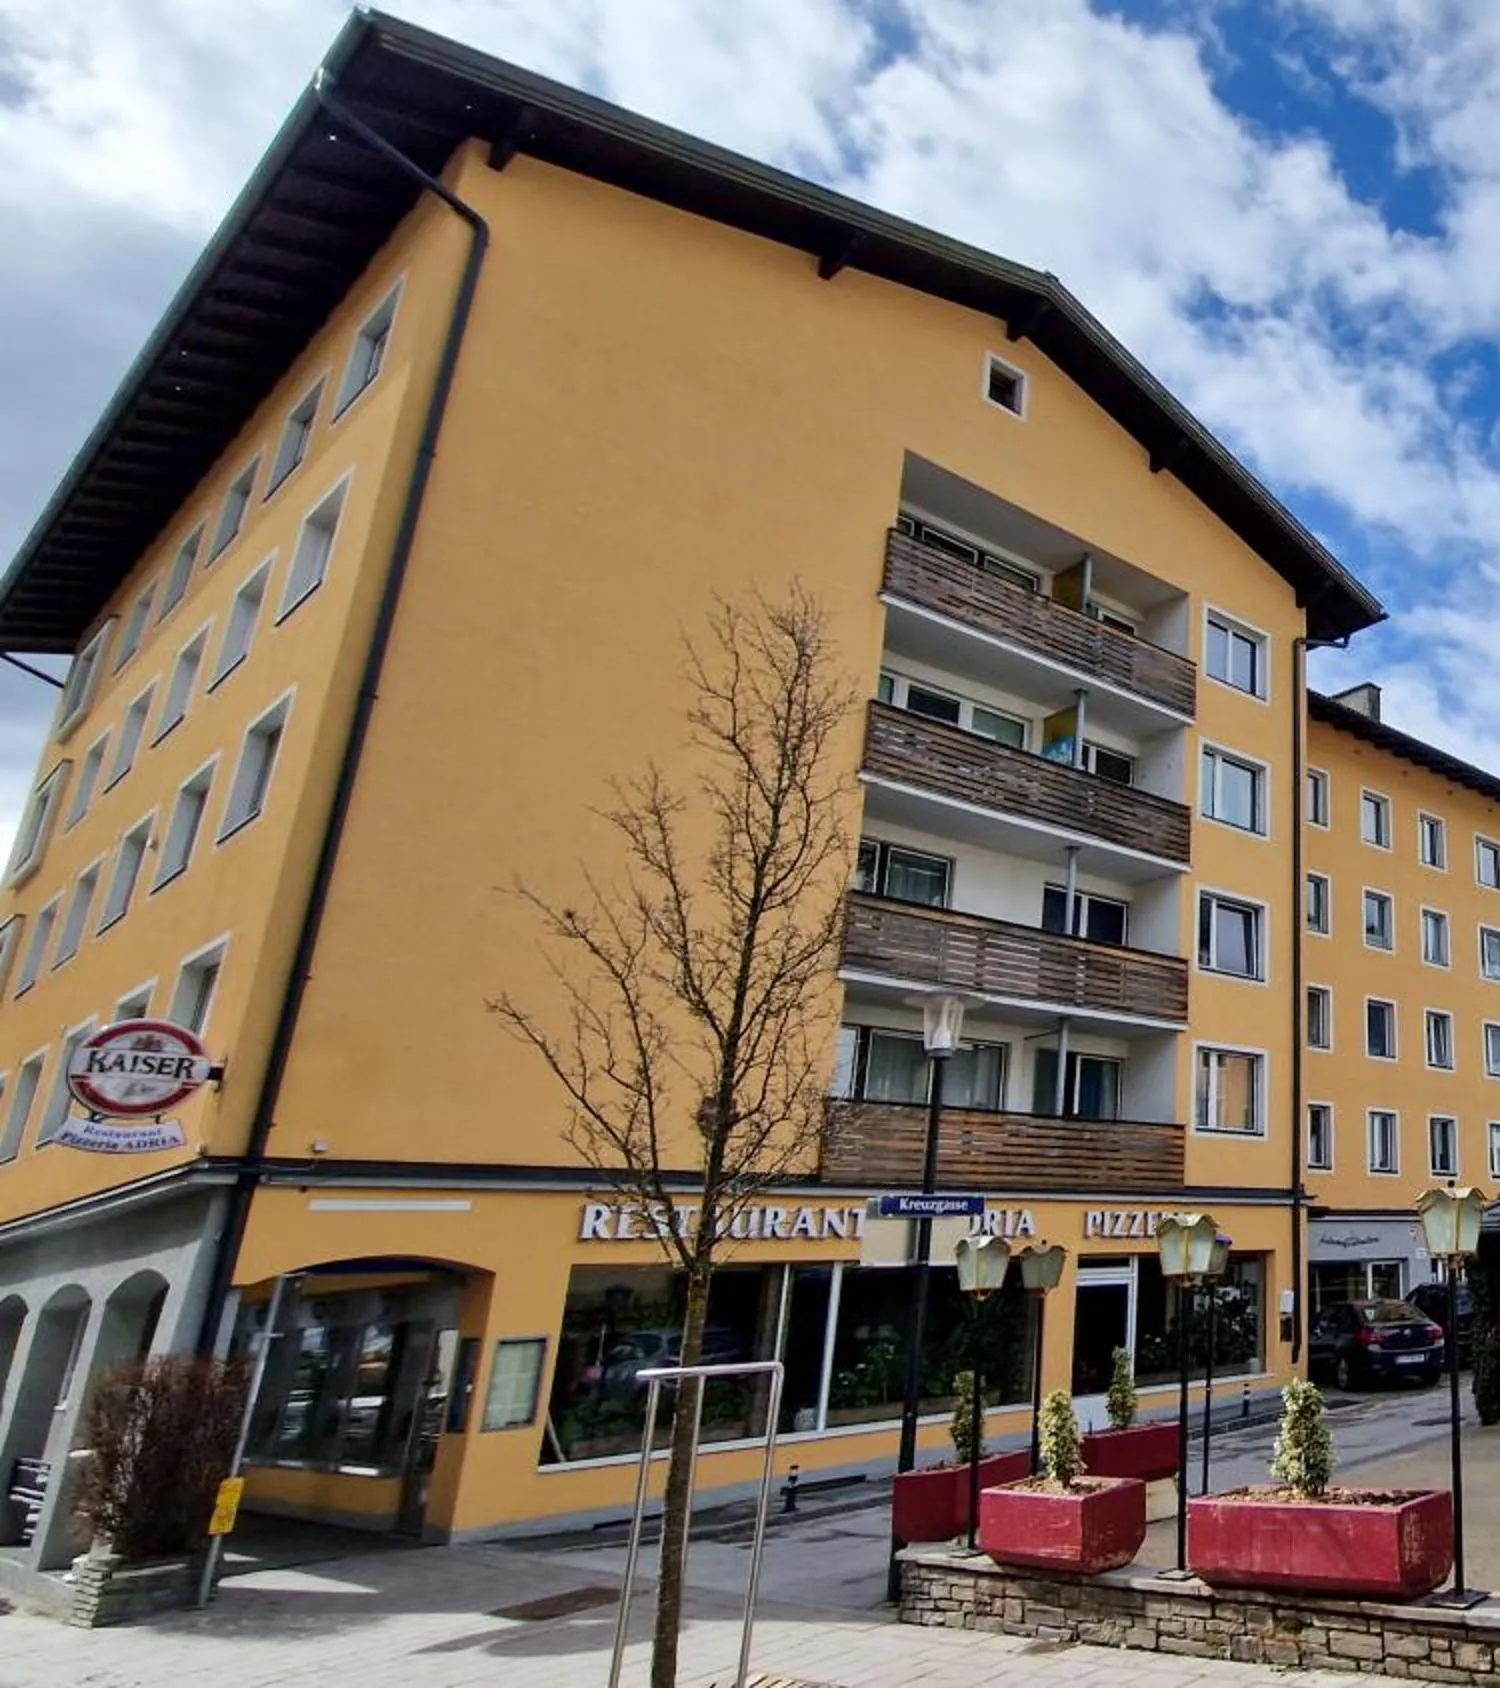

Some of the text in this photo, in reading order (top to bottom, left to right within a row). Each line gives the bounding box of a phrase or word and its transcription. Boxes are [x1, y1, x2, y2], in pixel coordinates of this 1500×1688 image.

[87, 1050, 195, 1079] KAISER
[83, 1125, 161, 1138] Restaurant
[125, 1135, 180, 1149] ADRIA
[899, 1198, 969, 1214] Kreuzgasse
[579, 1203, 868, 1240] RESTURANT
